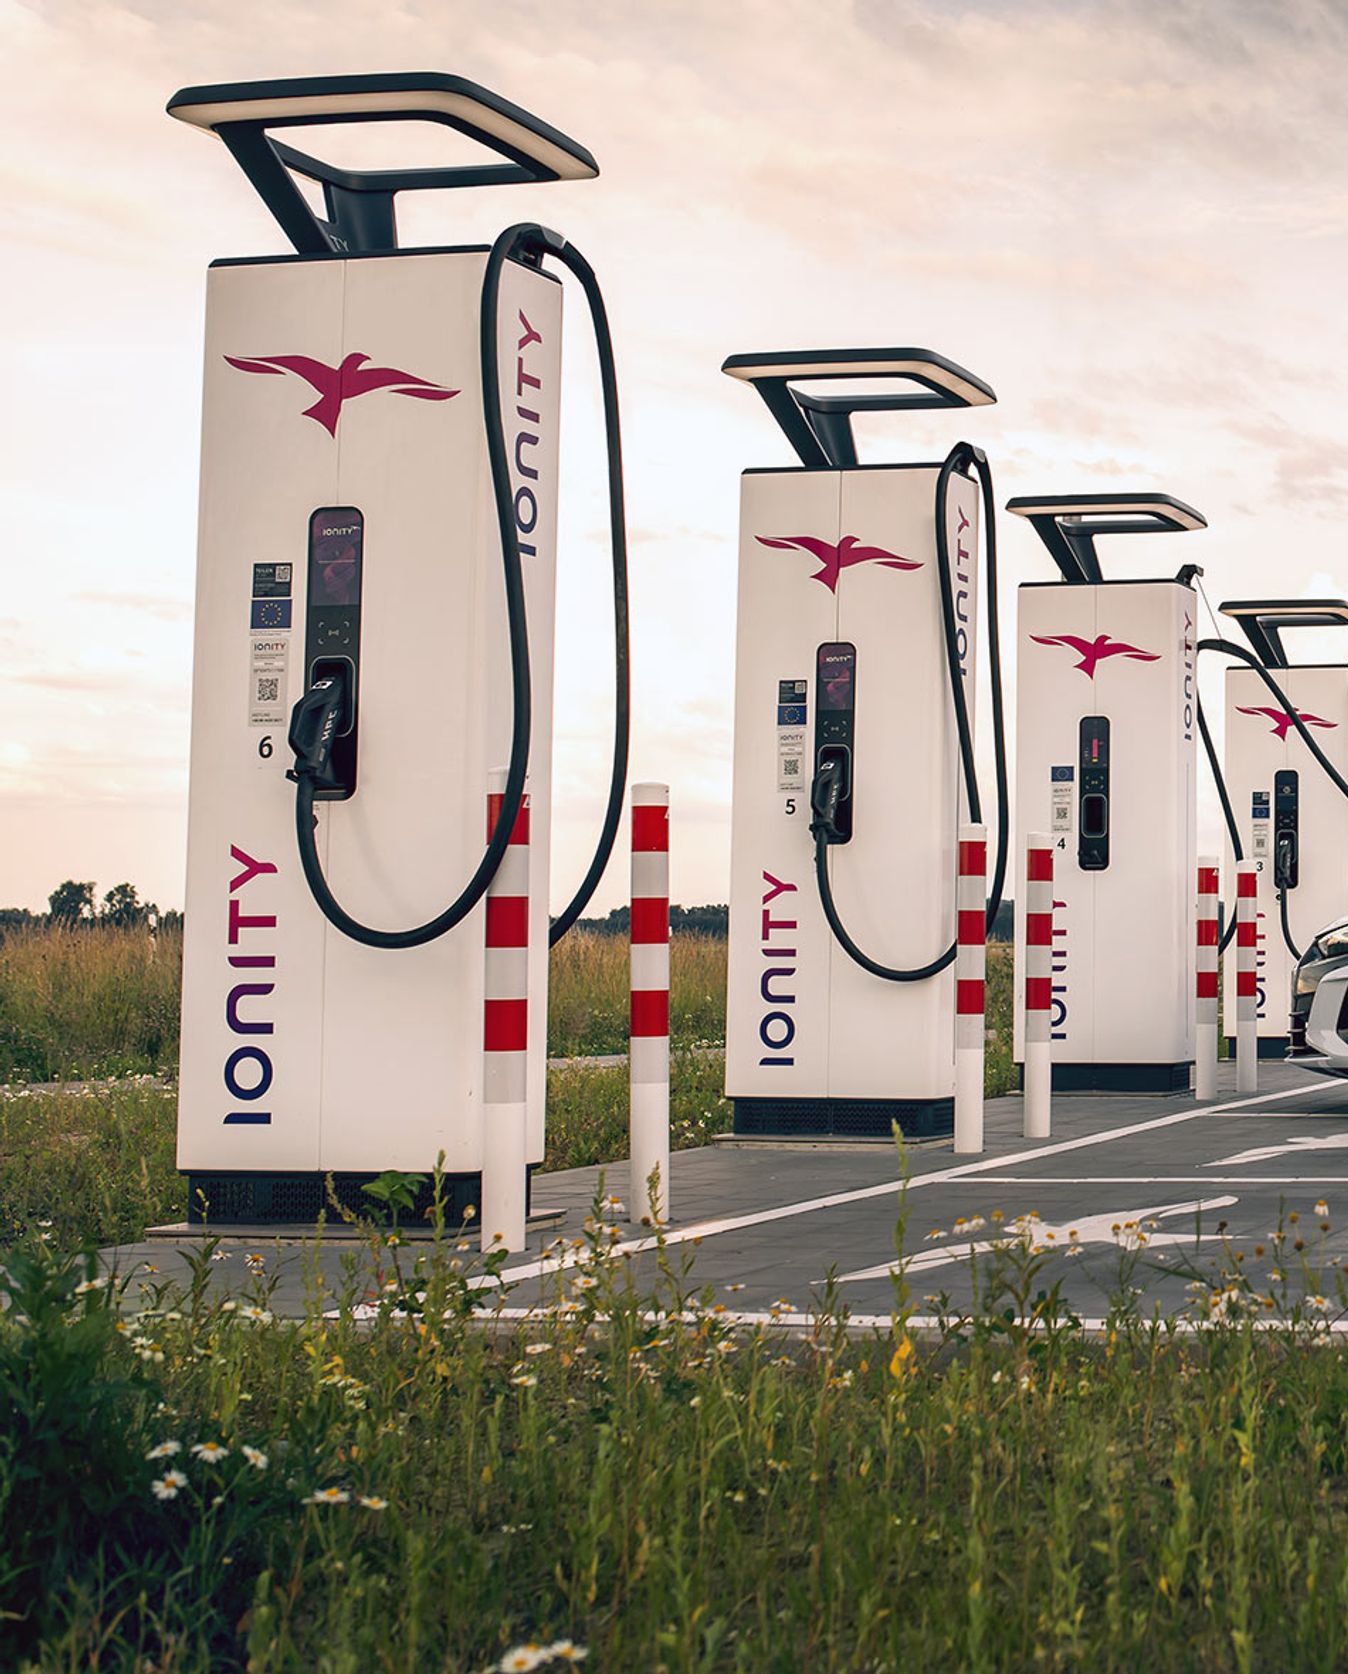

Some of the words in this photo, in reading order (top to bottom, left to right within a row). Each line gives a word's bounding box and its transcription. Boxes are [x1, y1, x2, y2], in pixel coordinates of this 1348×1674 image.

[514, 308, 543, 557] IONITY
[322, 528, 353, 536] IONITY
[955, 504, 970, 676] IONITY
[254, 643, 286, 651] IONITY
[1184, 611, 1192, 741] IONITY
[259, 735, 273, 758] 6
[785, 799, 796, 815] 5
[1057, 838, 1066, 850] 4
[1256, 861, 1264, 872] 3
[759, 870, 797, 1066] IONITY
[223, 844, 277, 1124] IONITY
